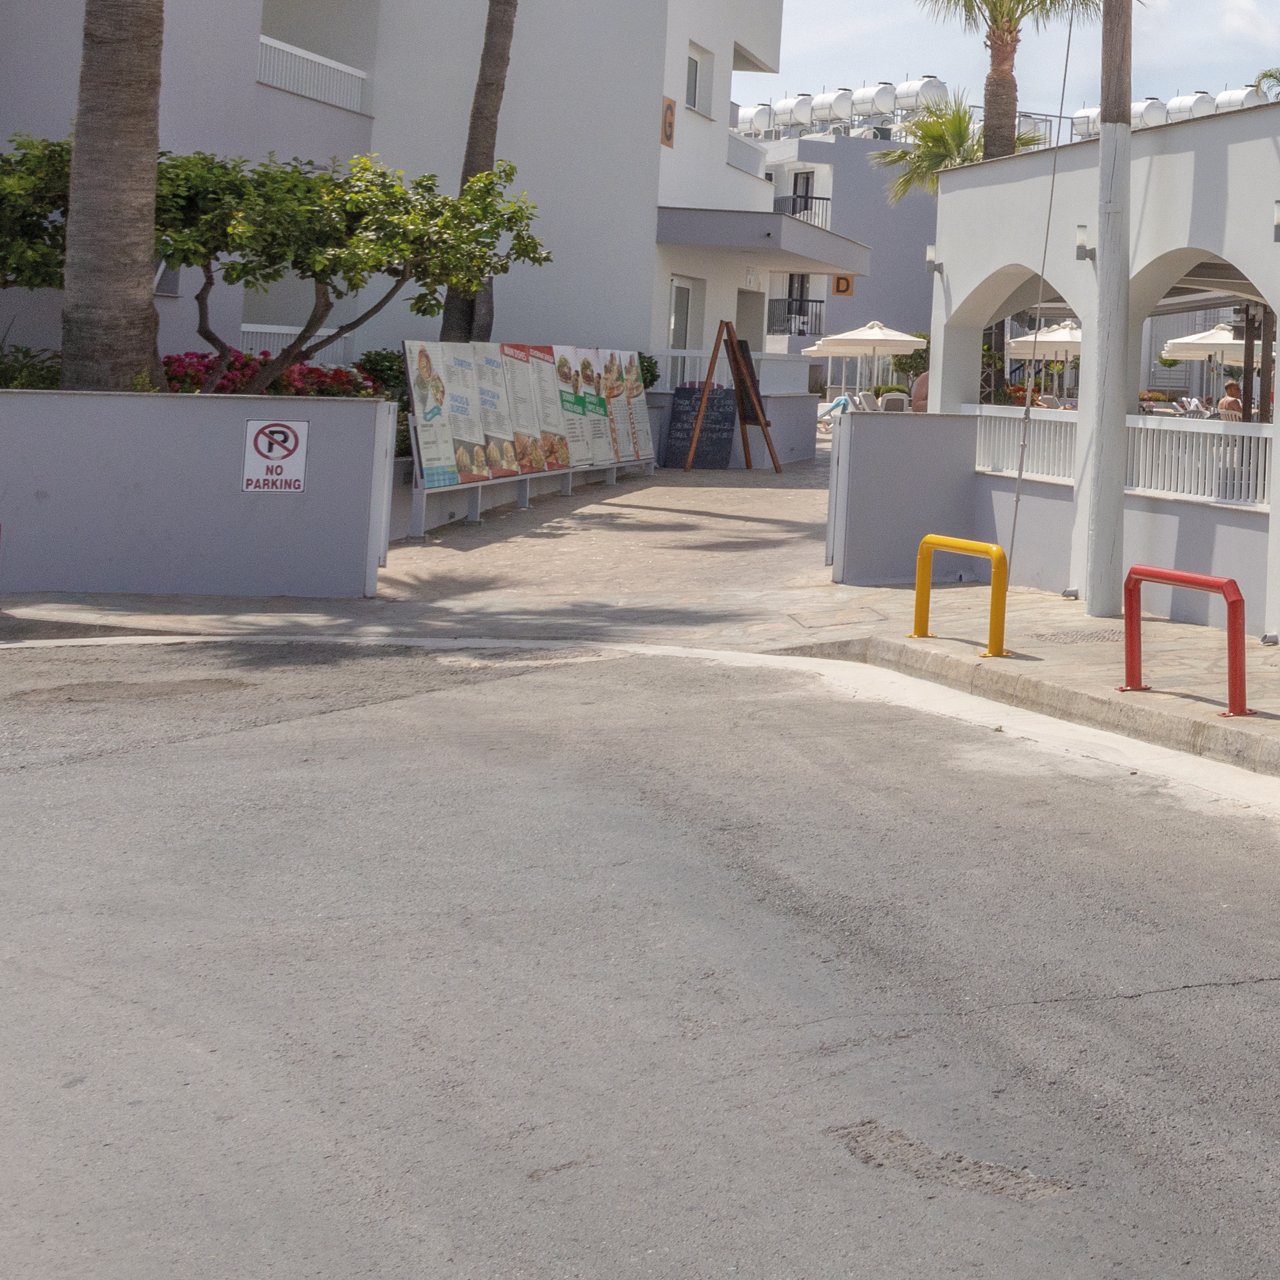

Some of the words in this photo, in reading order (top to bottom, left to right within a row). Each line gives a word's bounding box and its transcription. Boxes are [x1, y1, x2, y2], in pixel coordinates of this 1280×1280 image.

[664, 103, 674, 142] G
[836, 276, 850, 293] D
[265, 465, 283, 476] NO
[245, 478, 302, 490] PARKING
